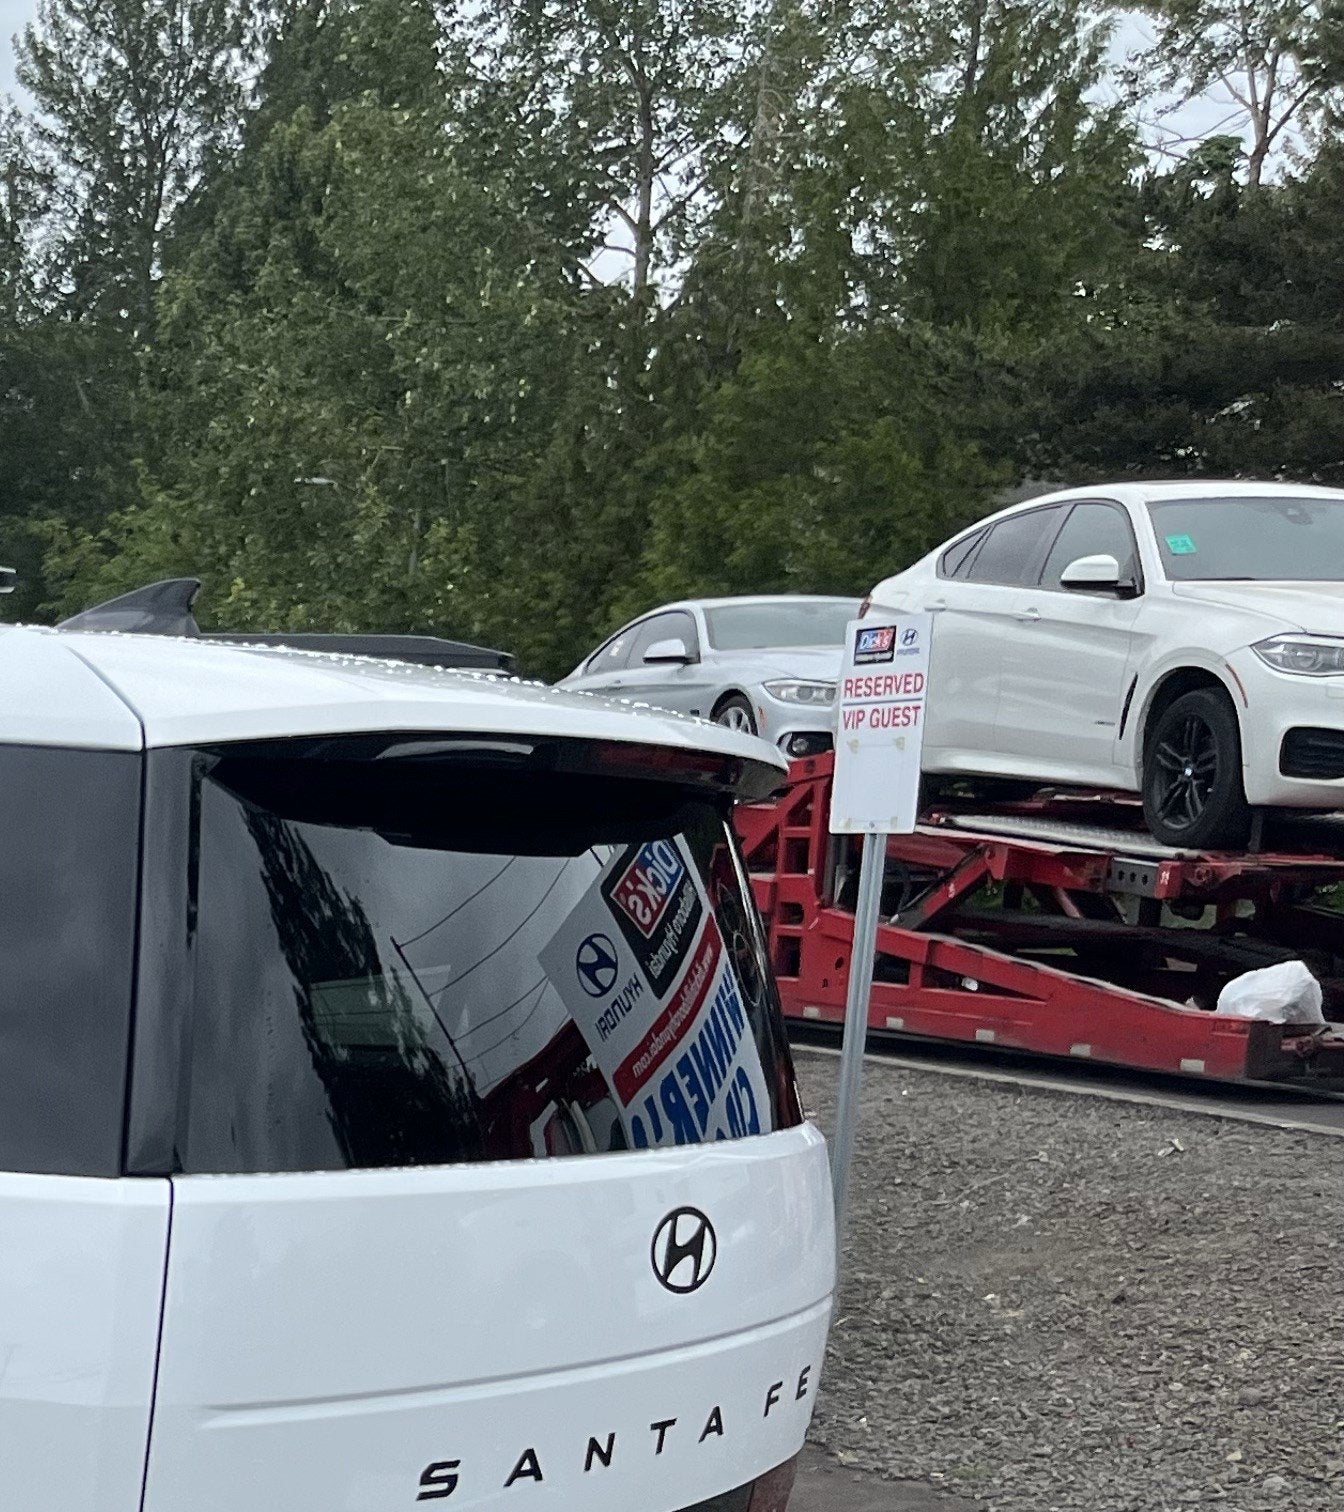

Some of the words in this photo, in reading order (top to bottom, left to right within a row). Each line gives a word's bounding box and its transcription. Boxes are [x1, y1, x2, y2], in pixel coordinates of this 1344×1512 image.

[844, 673, 924, 699] RESERVED
[842, 708, 866, 730] VIP
[869, 705, 921, 729] GUEST
[415, 1404, 726, 1502] SANTA
[763, 1364, 812, 1418] FE
